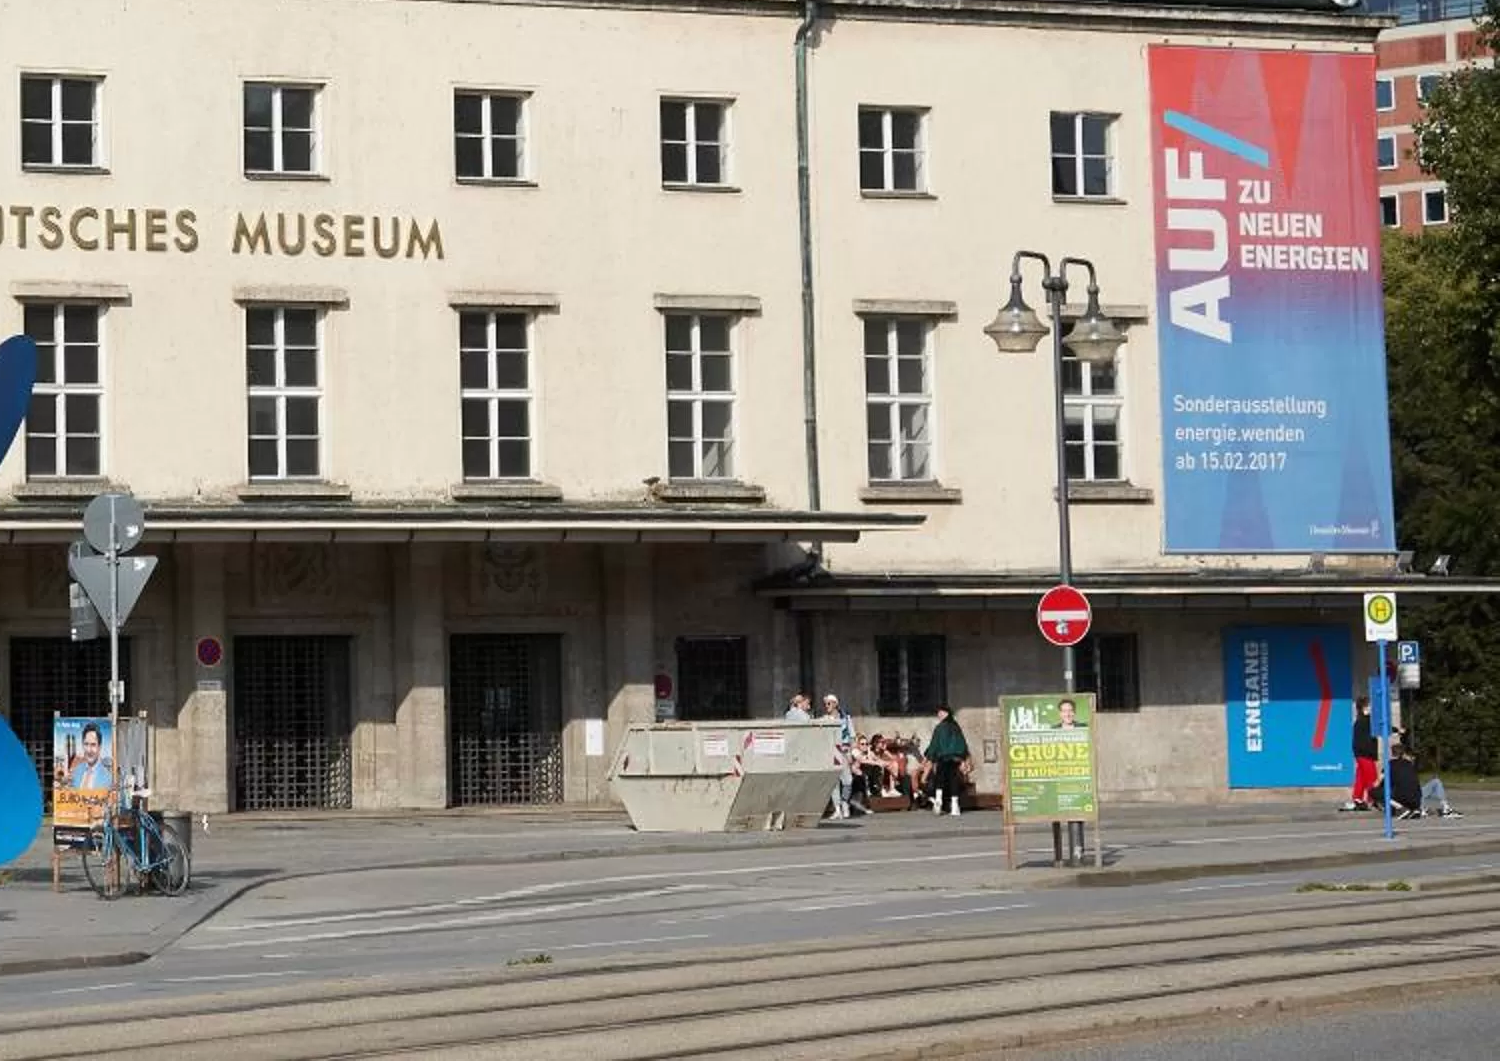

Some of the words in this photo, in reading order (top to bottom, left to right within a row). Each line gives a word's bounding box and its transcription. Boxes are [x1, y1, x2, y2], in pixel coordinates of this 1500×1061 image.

[1238, 179, 1271, 204] ZU
[231, 210, 445, 260] MUSEUM
[1239, 211, 1323, 238] NEUEN
[1240, 244, 1369, 271] ENERGIEN
[1173, 394, 1328, 418] Sonderausstellung
[1175, 423, 1305, 446] energie.wenden
[1175, 452, 1196, 470] ab
[1201, 451, 1287, 471] 15.02.2017
[1401, 644, 1413, 662] P
[1243, 640, 1263, 752] EINGANG
